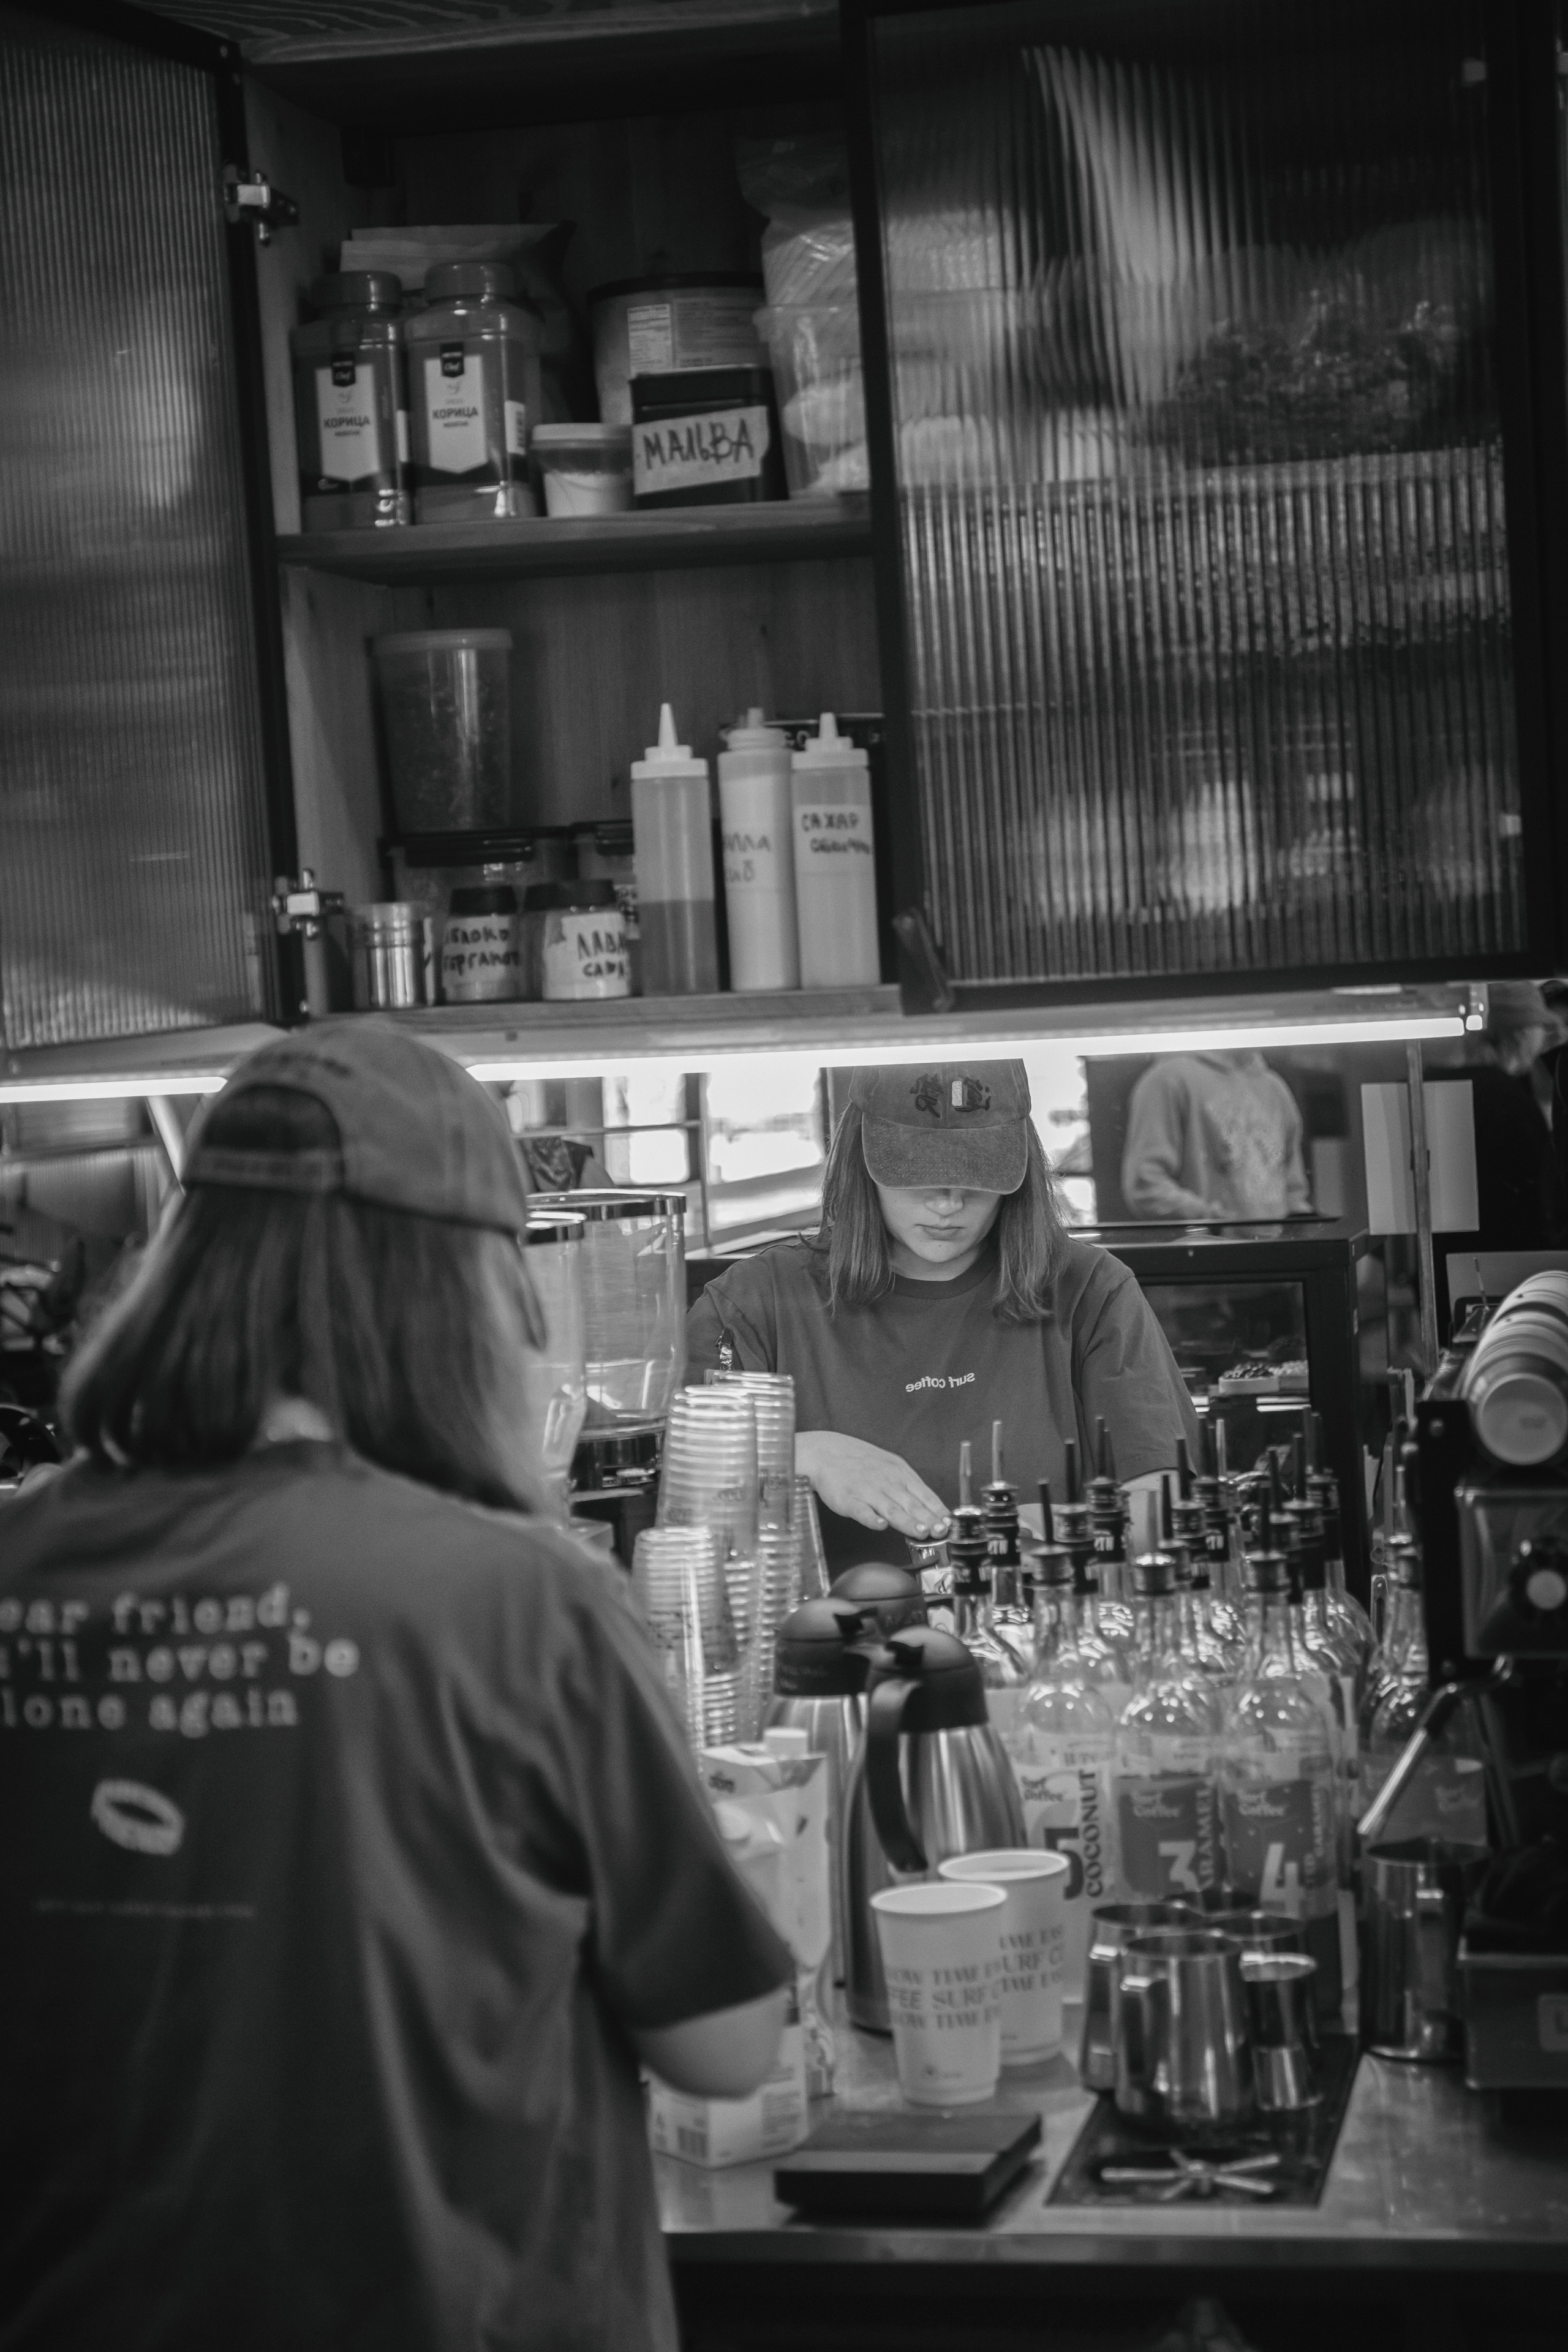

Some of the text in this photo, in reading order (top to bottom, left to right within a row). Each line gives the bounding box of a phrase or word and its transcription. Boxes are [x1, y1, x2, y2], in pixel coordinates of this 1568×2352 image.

[323, 415, 371, 429] КОРИЦА
[432, 406, 479, 420] КОРИЦА
[643, 417, 755, 470] МАЛЬВА
[108, 1641, 269, 1683] never
[288, 1627, 361, 1678] be
[148, 1687, 298, 1739] again
[1079, 1770, 1104, 1898] COCONUT
[1259, 1841, 1305, 1917] 4
